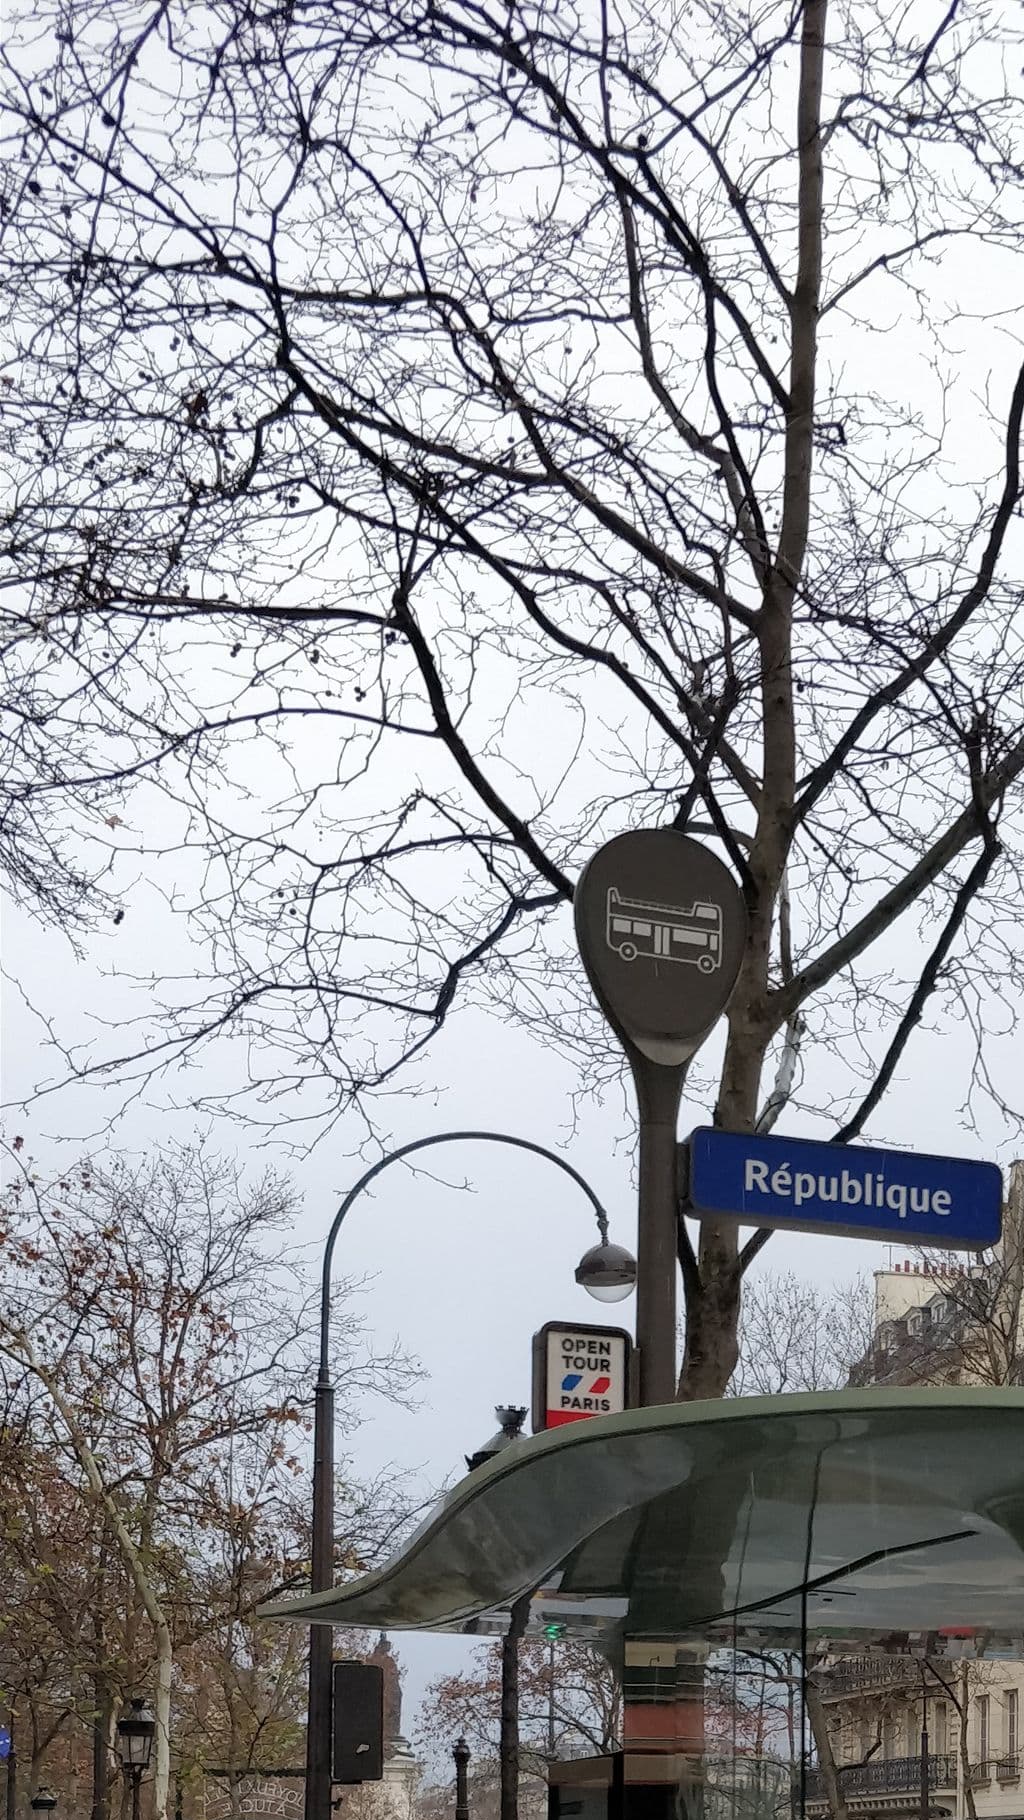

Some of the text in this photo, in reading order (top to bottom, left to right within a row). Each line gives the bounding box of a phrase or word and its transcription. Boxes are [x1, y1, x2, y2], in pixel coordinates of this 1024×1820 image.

[744, 1159, 952, 1217] République
[561, 1338, 611, 1355] OPEN
[561, 1355, 611, 1373] TOUR
[561, 1395, 611, 1412] PARIS
